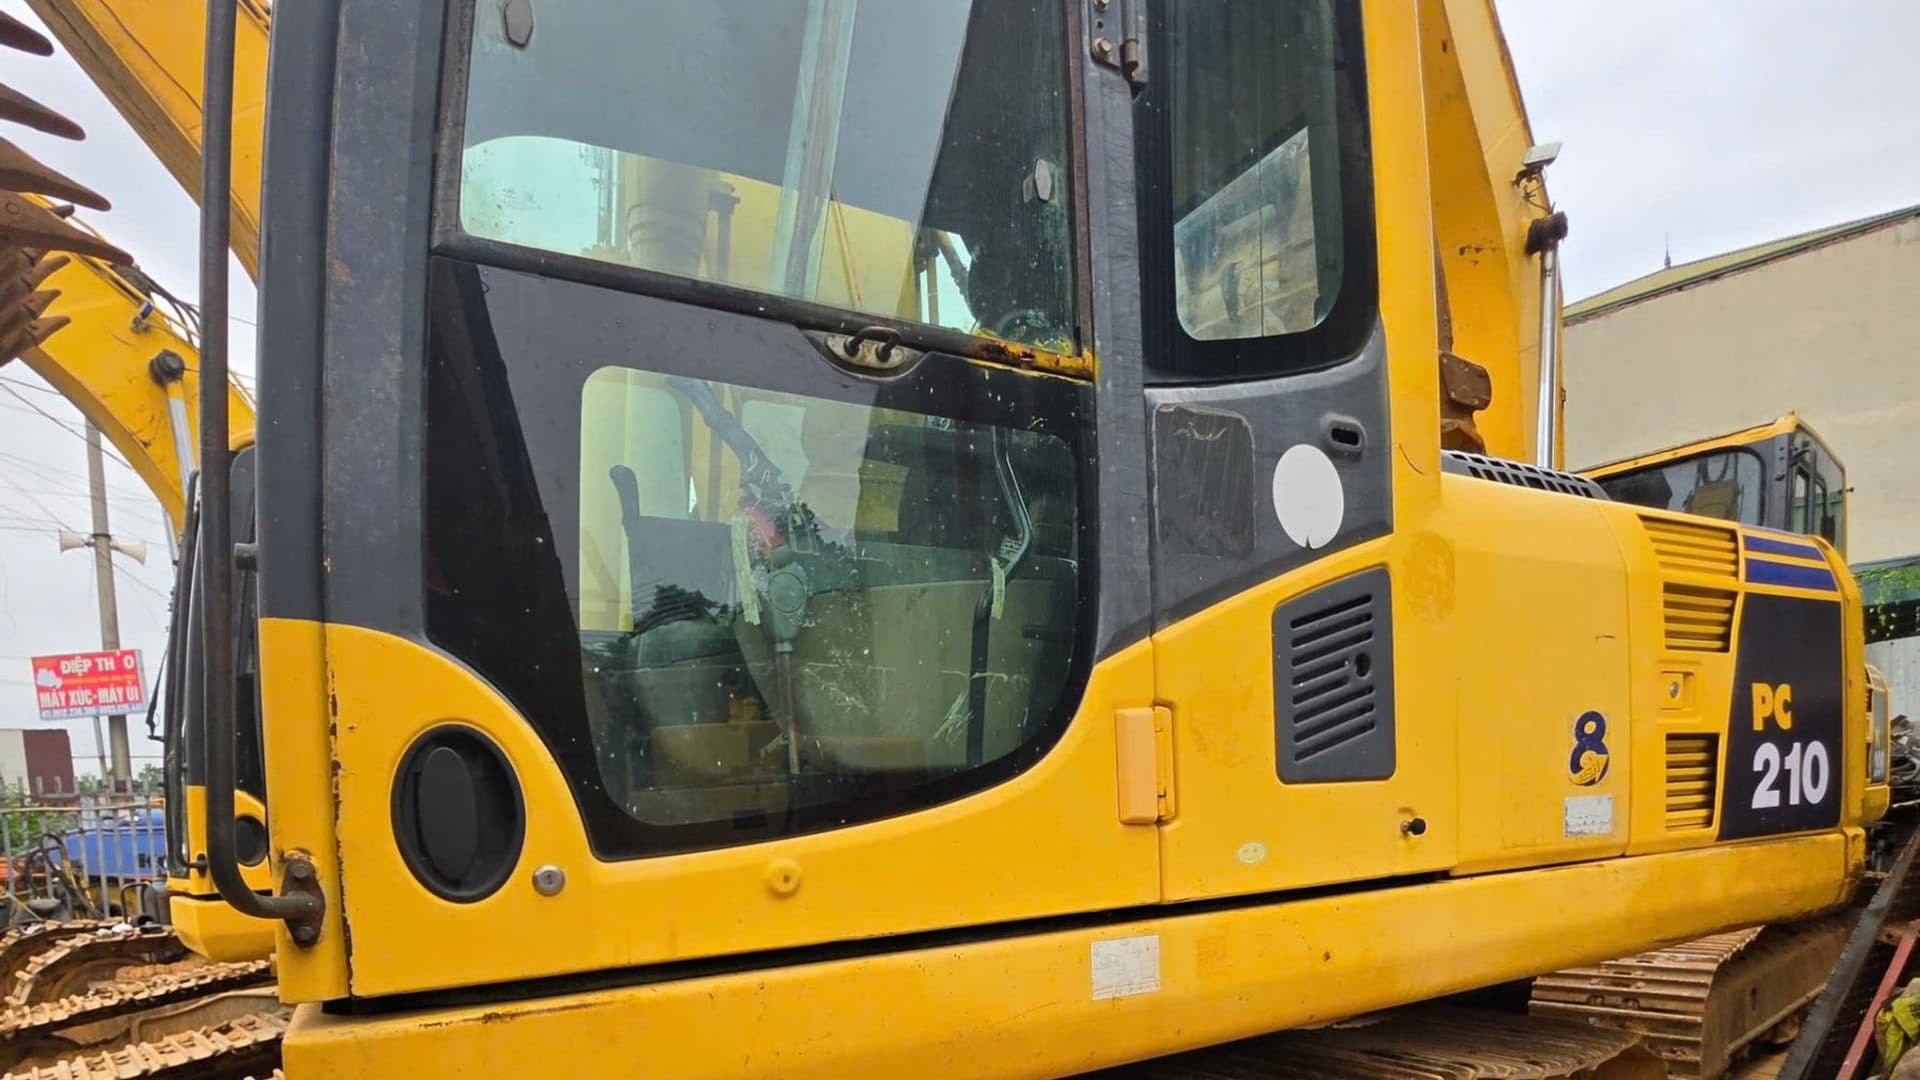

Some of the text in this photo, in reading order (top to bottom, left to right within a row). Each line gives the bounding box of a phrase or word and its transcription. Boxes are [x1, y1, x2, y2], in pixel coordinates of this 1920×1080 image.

[95, 651, 135, 671] THO
[40, 688, 66, 708] MÁY
[1752, 682, 1792, 731] PC
[1751, 740, 1830, 809] 210
